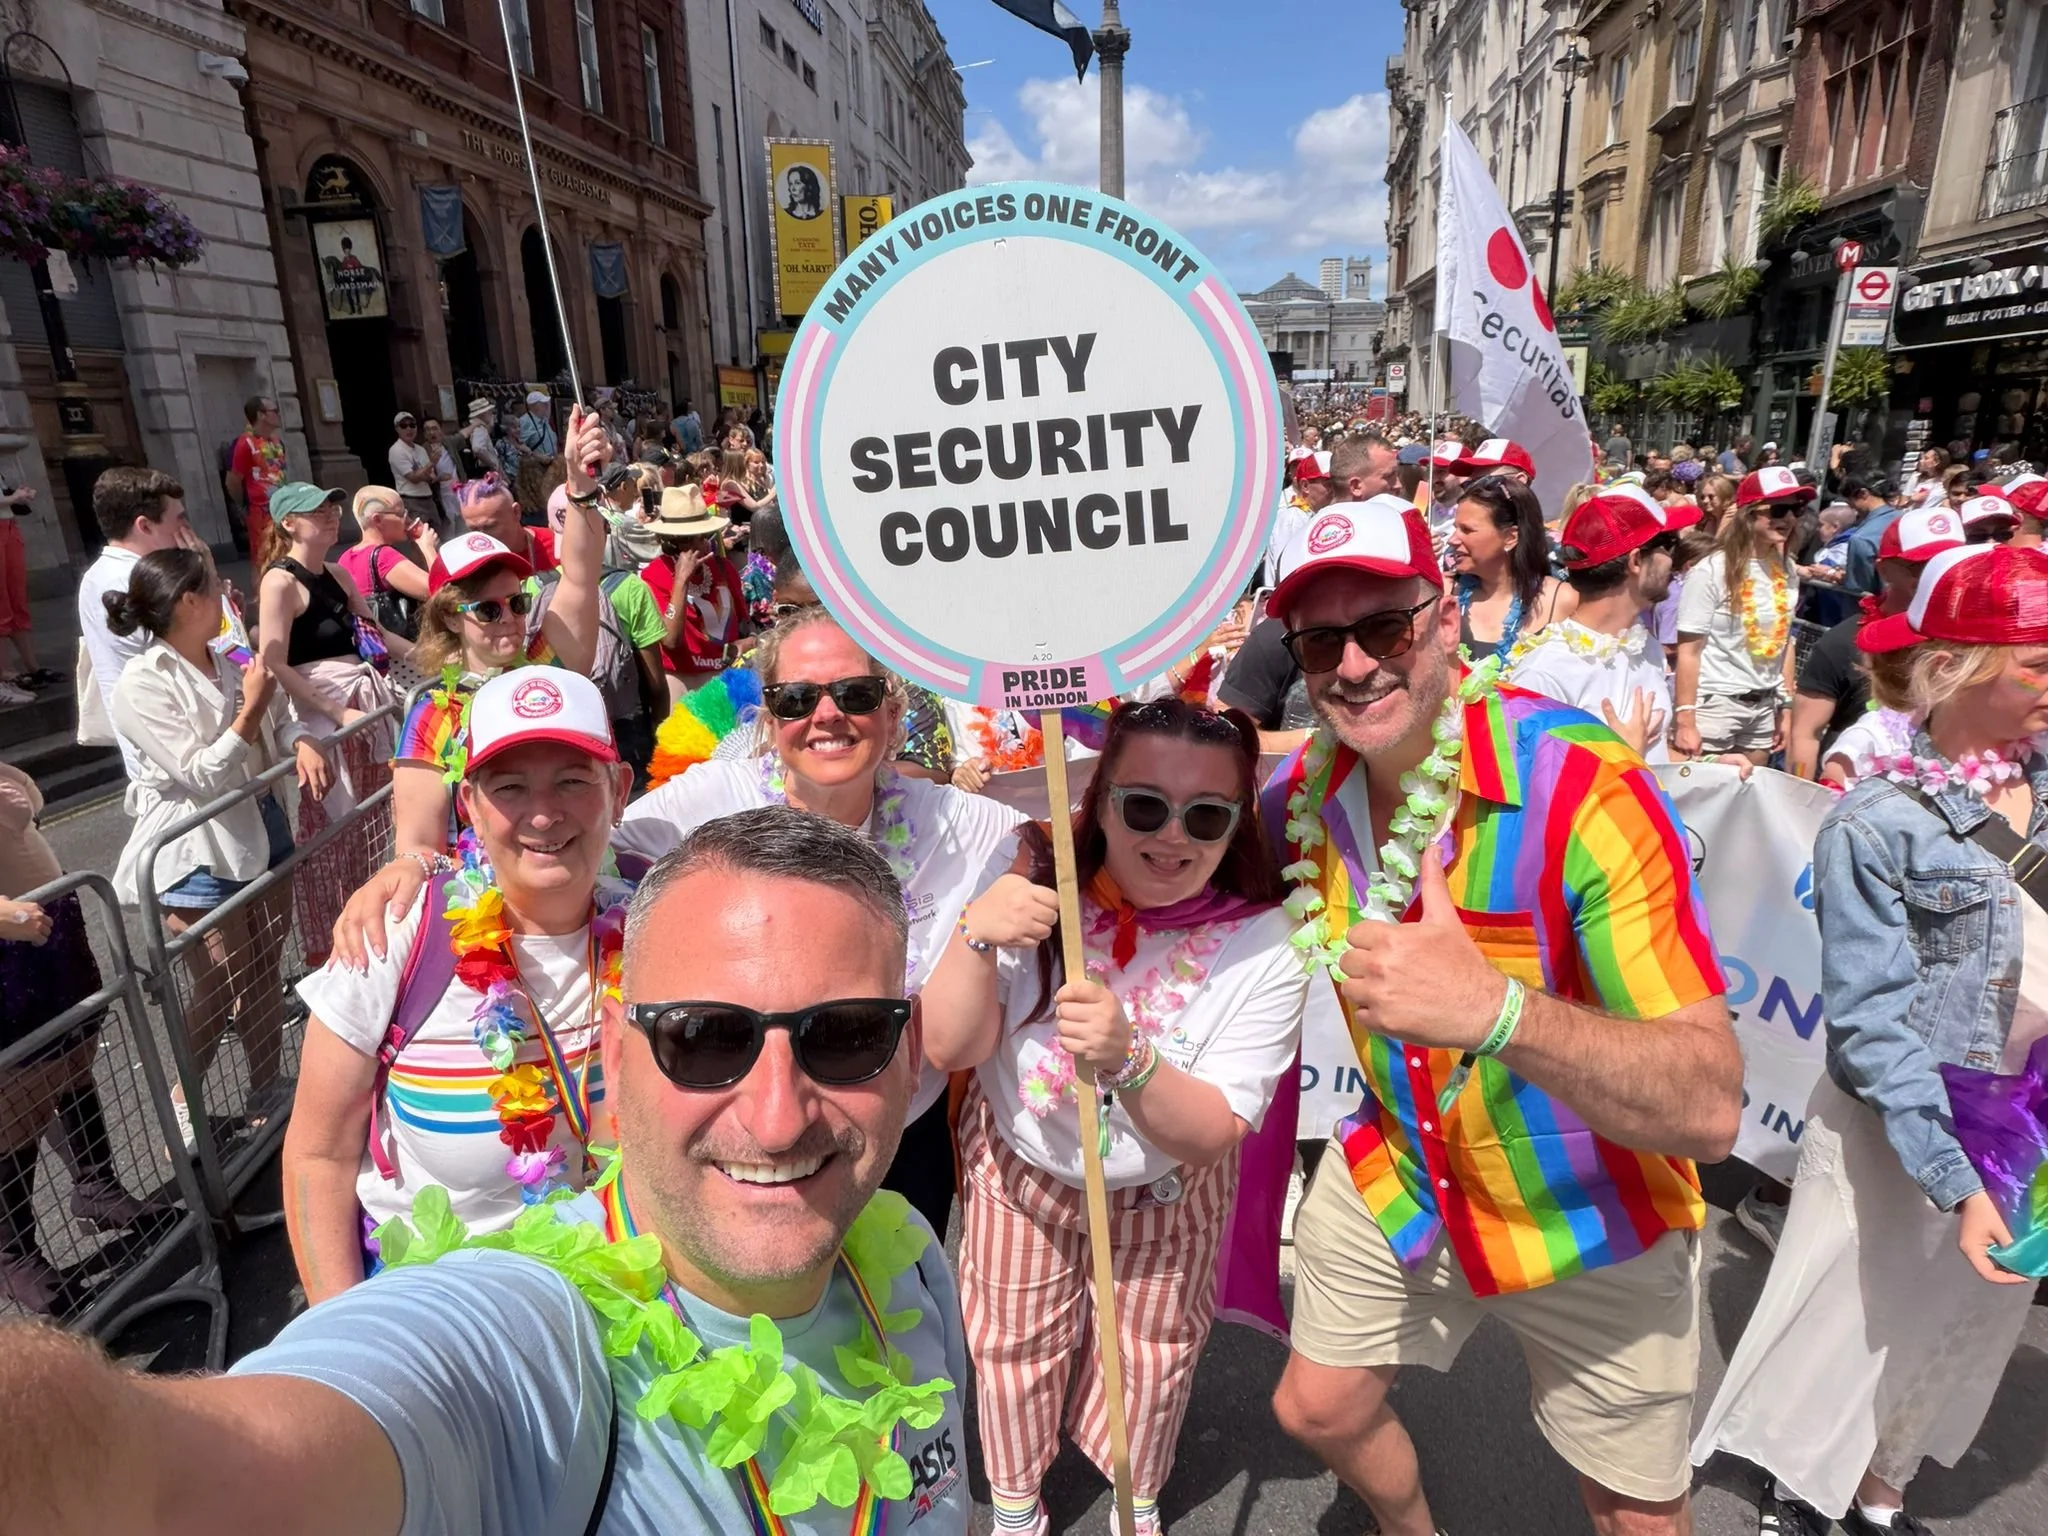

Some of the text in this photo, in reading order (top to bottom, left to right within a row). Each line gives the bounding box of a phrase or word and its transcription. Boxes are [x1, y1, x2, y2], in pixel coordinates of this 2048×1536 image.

[463, 129, 491, 158] THE
[494, 145, 531, 172] HORS
[550, 169, 613, 205] GUARDSMAN
[823, 192, 1200, 325] MANY VOICES ONE FRONT
[1840, 245, 1860, 264] M
[1902, 277, 1962, 312] GIFT
[1961, 266, 2024, 302] BOX
[1946, 309, 1981, 327] HARRY
[1981, 304, 2026, 322] POTTER
[932, 332, 1098, 406] CITY
[849, 404, 1203, 493] SECURITY
[879, 488, 1189, 567] COUNCIL
[691, 655, 723, 669] Vang
[1005, 691, 1088, 708] IN LONDON
[1760, 1102, 1805, 1145] IN
[908, 1427, 956, 1503] ASIS
